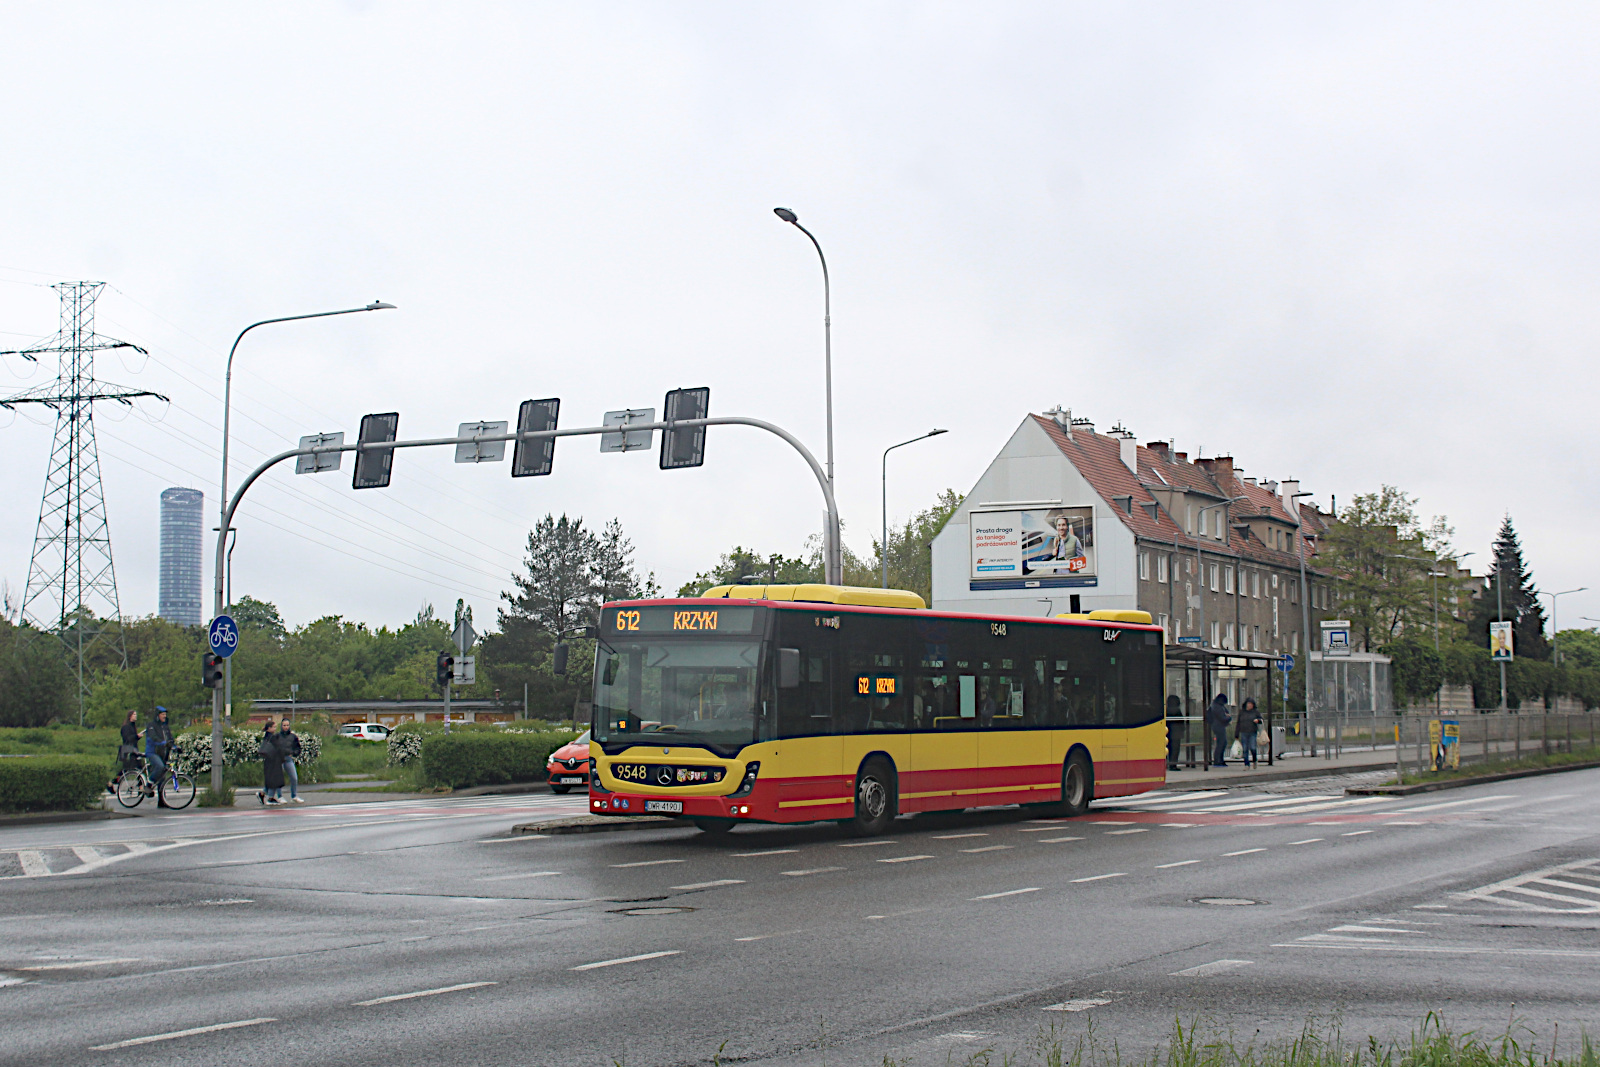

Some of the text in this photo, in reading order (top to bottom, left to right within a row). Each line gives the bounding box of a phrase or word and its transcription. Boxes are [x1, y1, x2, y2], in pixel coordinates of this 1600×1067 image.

[1072, 560, 1082, 570] 19
[616, 610, 718, 630] 612 KRZYKI
[990, 622, 1006, 636] 9548
[1104, 629, 1118, 640] DLA
[858, 677, 896, 694] 612 KRZYKI
[617, 764, 647, 780] 9548
